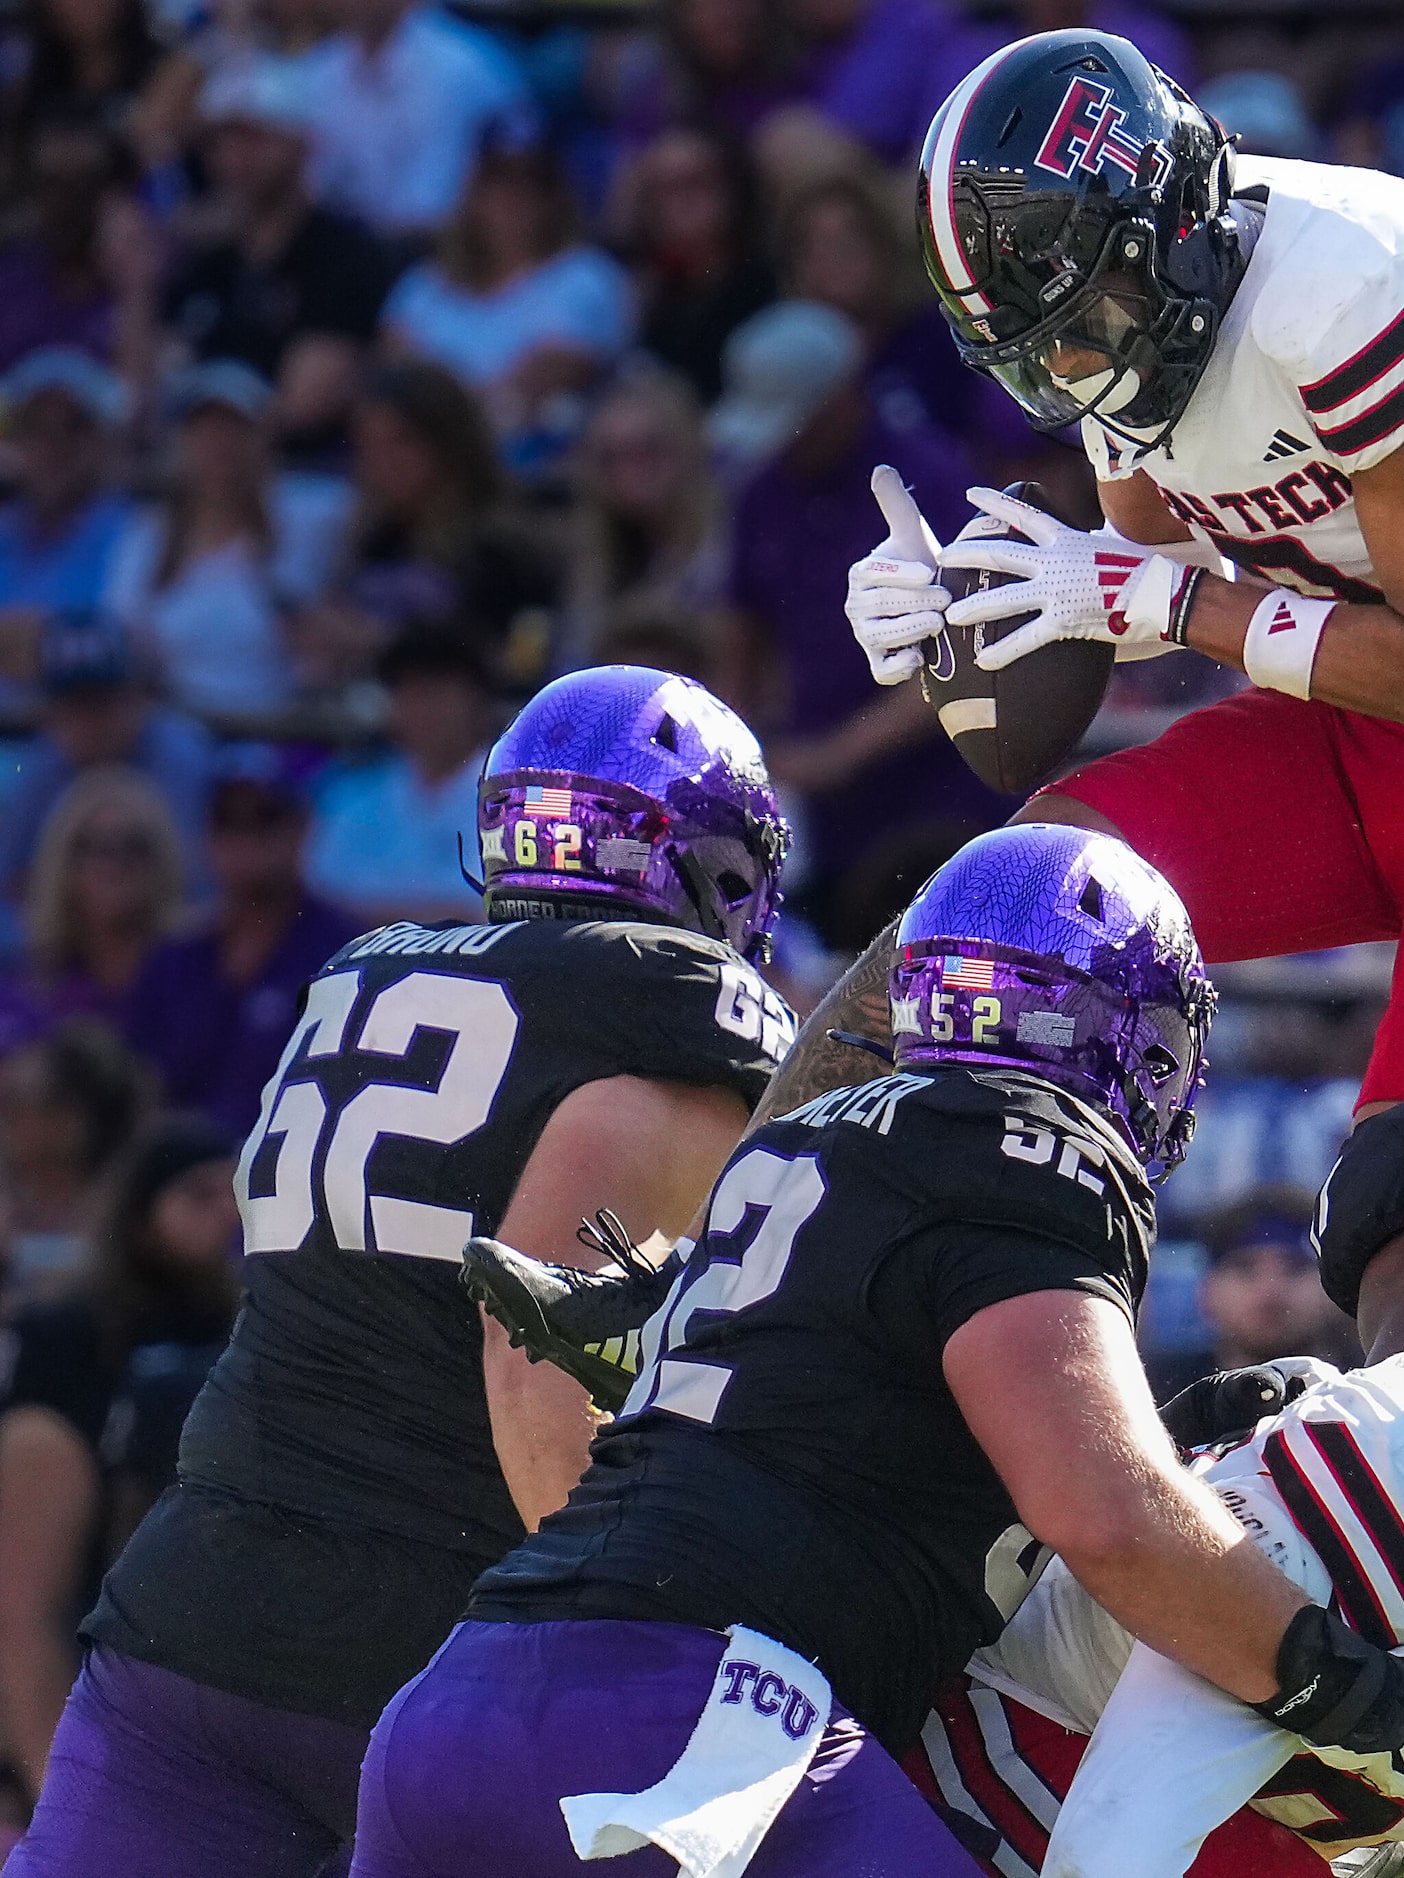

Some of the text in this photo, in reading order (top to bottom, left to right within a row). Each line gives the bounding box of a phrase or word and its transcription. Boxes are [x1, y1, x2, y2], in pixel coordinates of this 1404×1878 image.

[1210, 459, 1353, 534] TECH
[514, 819, 582, 871] 62
[930, 992, 1001, 1045] 52
[232, 968, 522, 1264] 62
[719, 1658, 821, 1742] TCU
